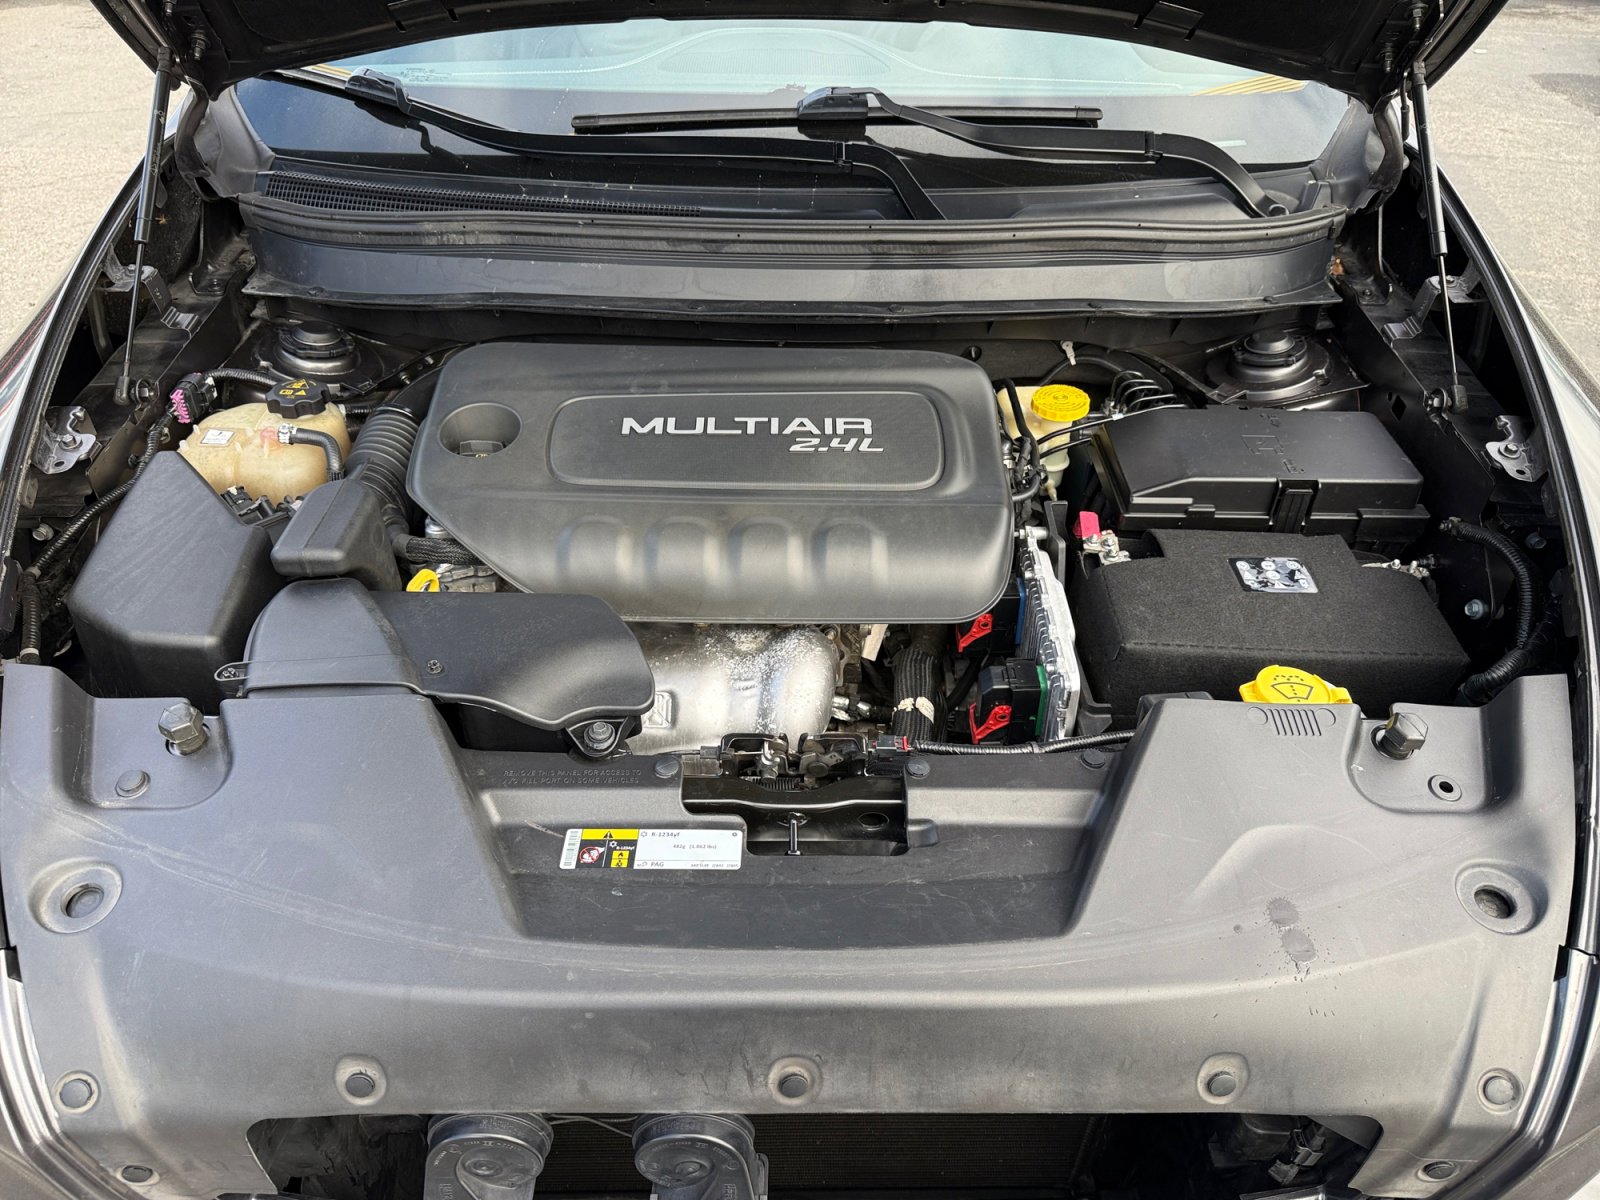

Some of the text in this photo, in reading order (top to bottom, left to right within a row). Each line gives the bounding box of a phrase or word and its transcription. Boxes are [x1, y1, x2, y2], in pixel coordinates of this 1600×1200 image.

[621, 416, 873, 436] MULTIAIR
[788, 437, 885, 453] 2.4L
[583, 769, 599, 777] FOR
[600, 769, 631, 777] ACCESS
[632, 769, 643, 777] TO
